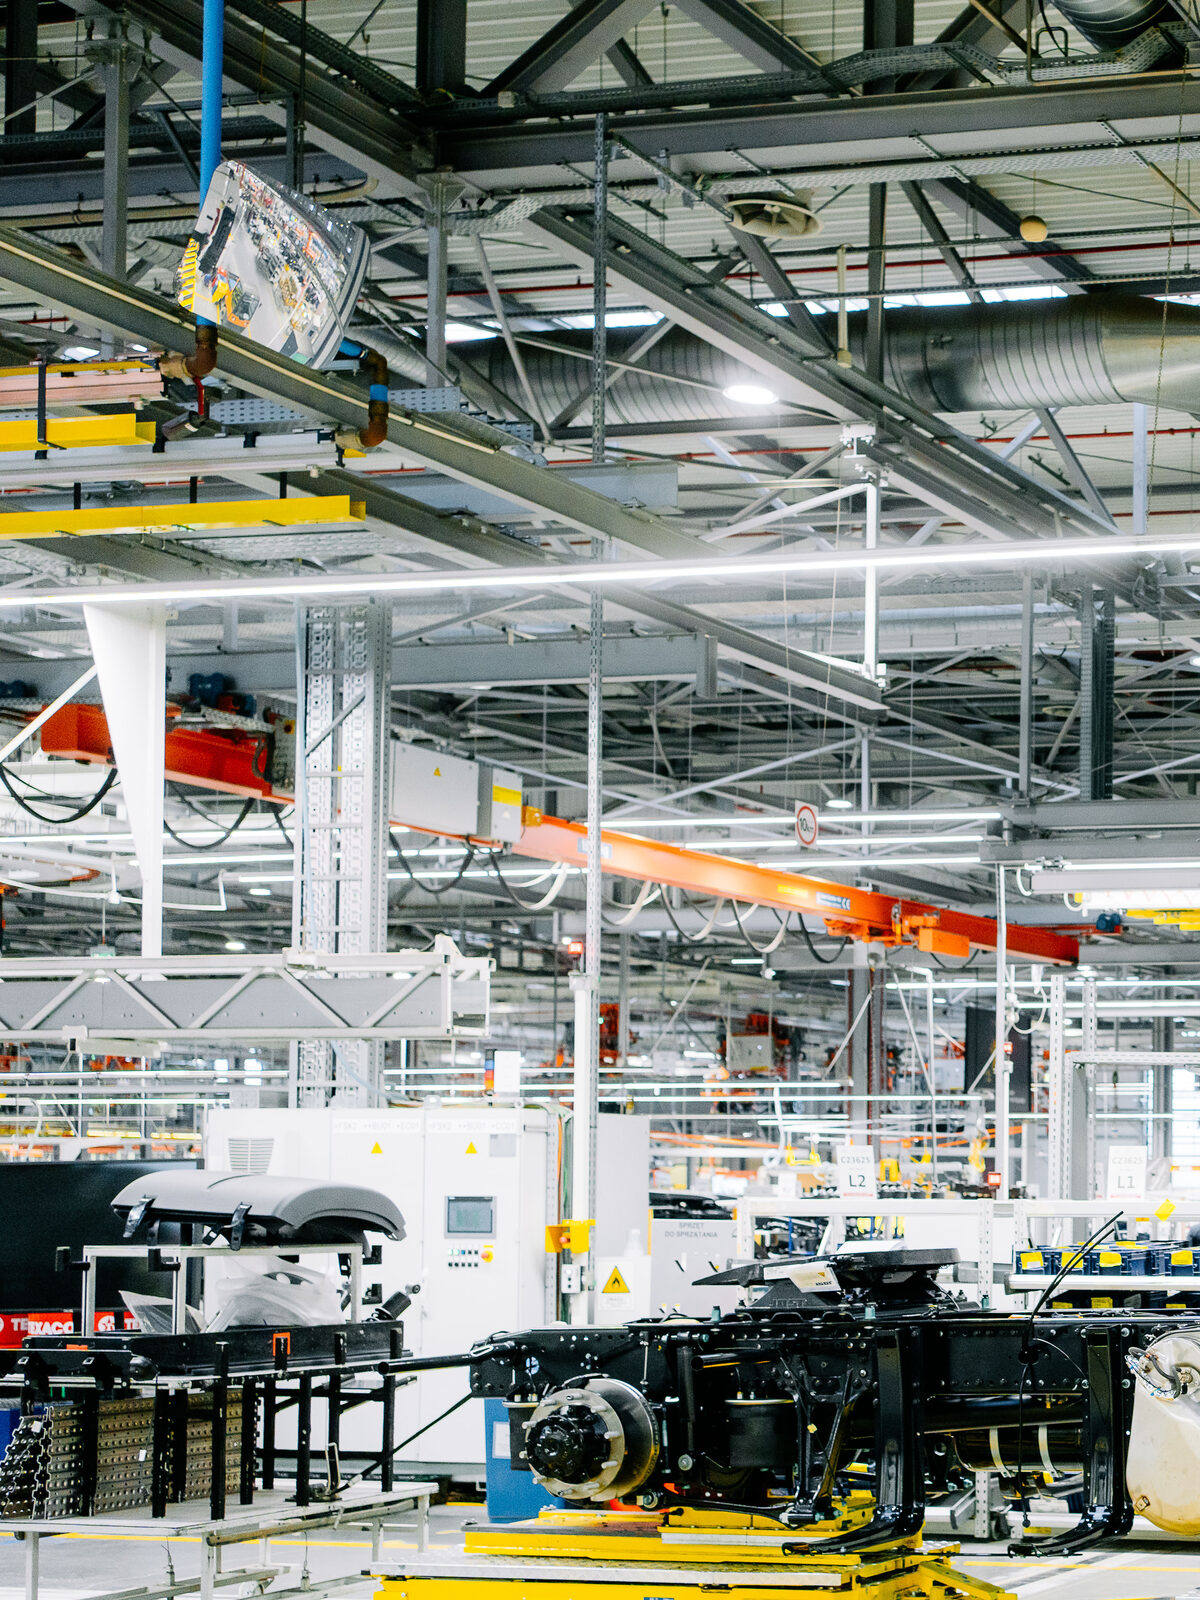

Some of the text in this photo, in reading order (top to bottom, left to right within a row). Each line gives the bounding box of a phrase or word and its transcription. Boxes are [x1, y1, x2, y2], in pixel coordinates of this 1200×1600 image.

[848, 1174, 866, 1188] L2
[1117, 1175, 1136, 1189] L1
[28, 1320, 74, 1335] EXACO
